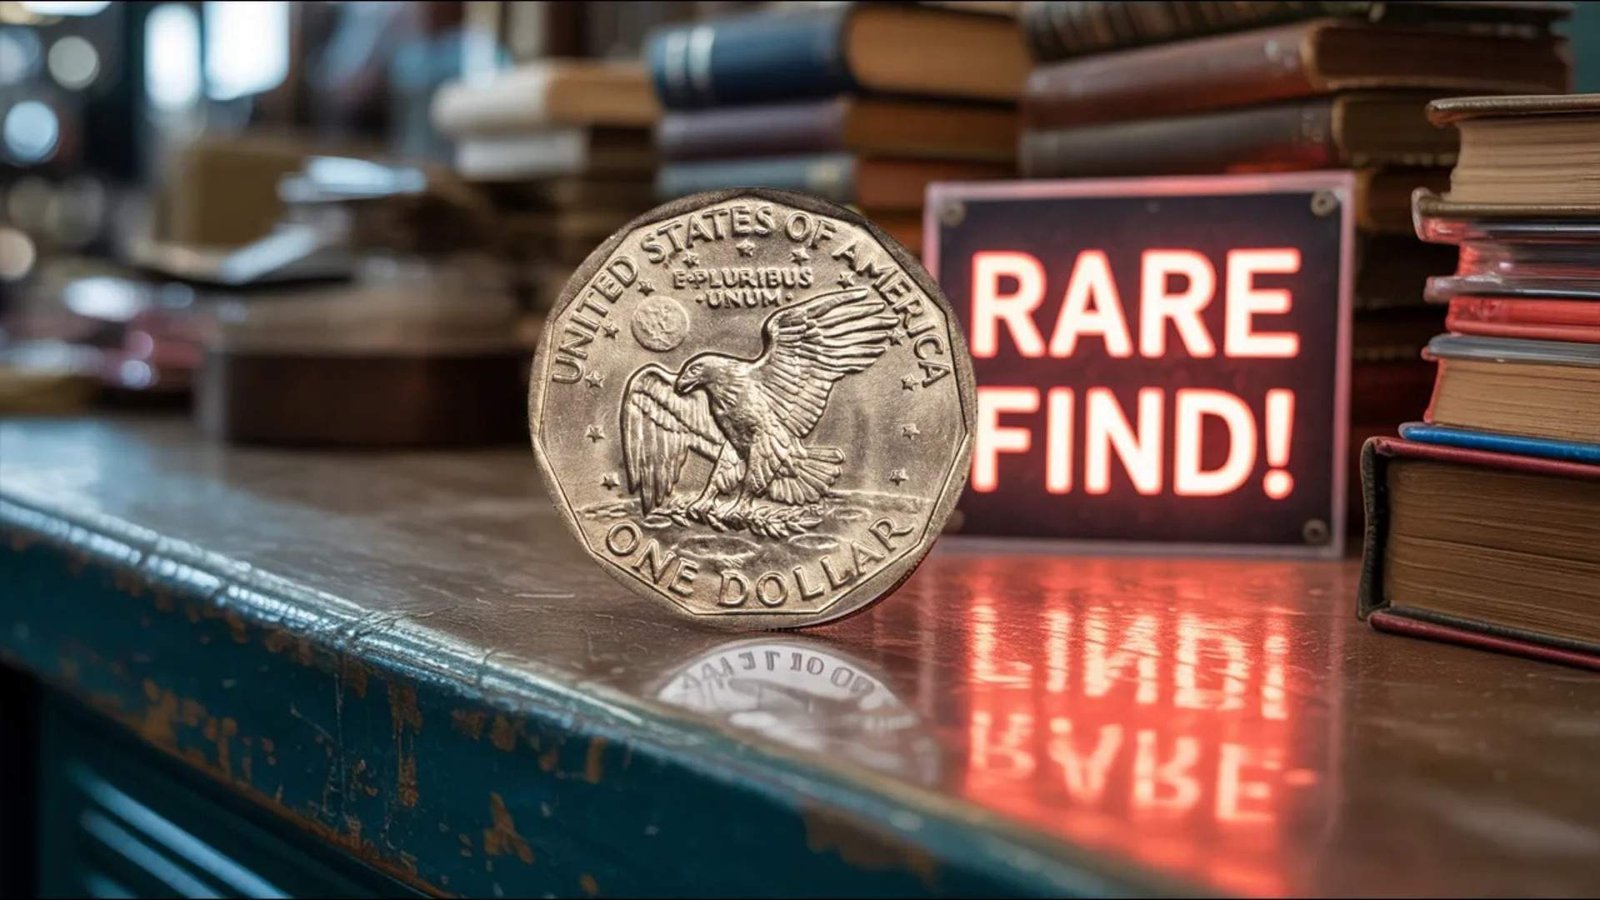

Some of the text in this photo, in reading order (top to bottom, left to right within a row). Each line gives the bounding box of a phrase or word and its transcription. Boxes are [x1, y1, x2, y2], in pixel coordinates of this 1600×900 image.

[552, 206, 951, 389] UNITED STATES OF AMERICA
[970, 248, 1301, 358] RARE
[970, 386, 1295, 499] FIND!
[605, 516, 915, 609] ONE DOLLAR
